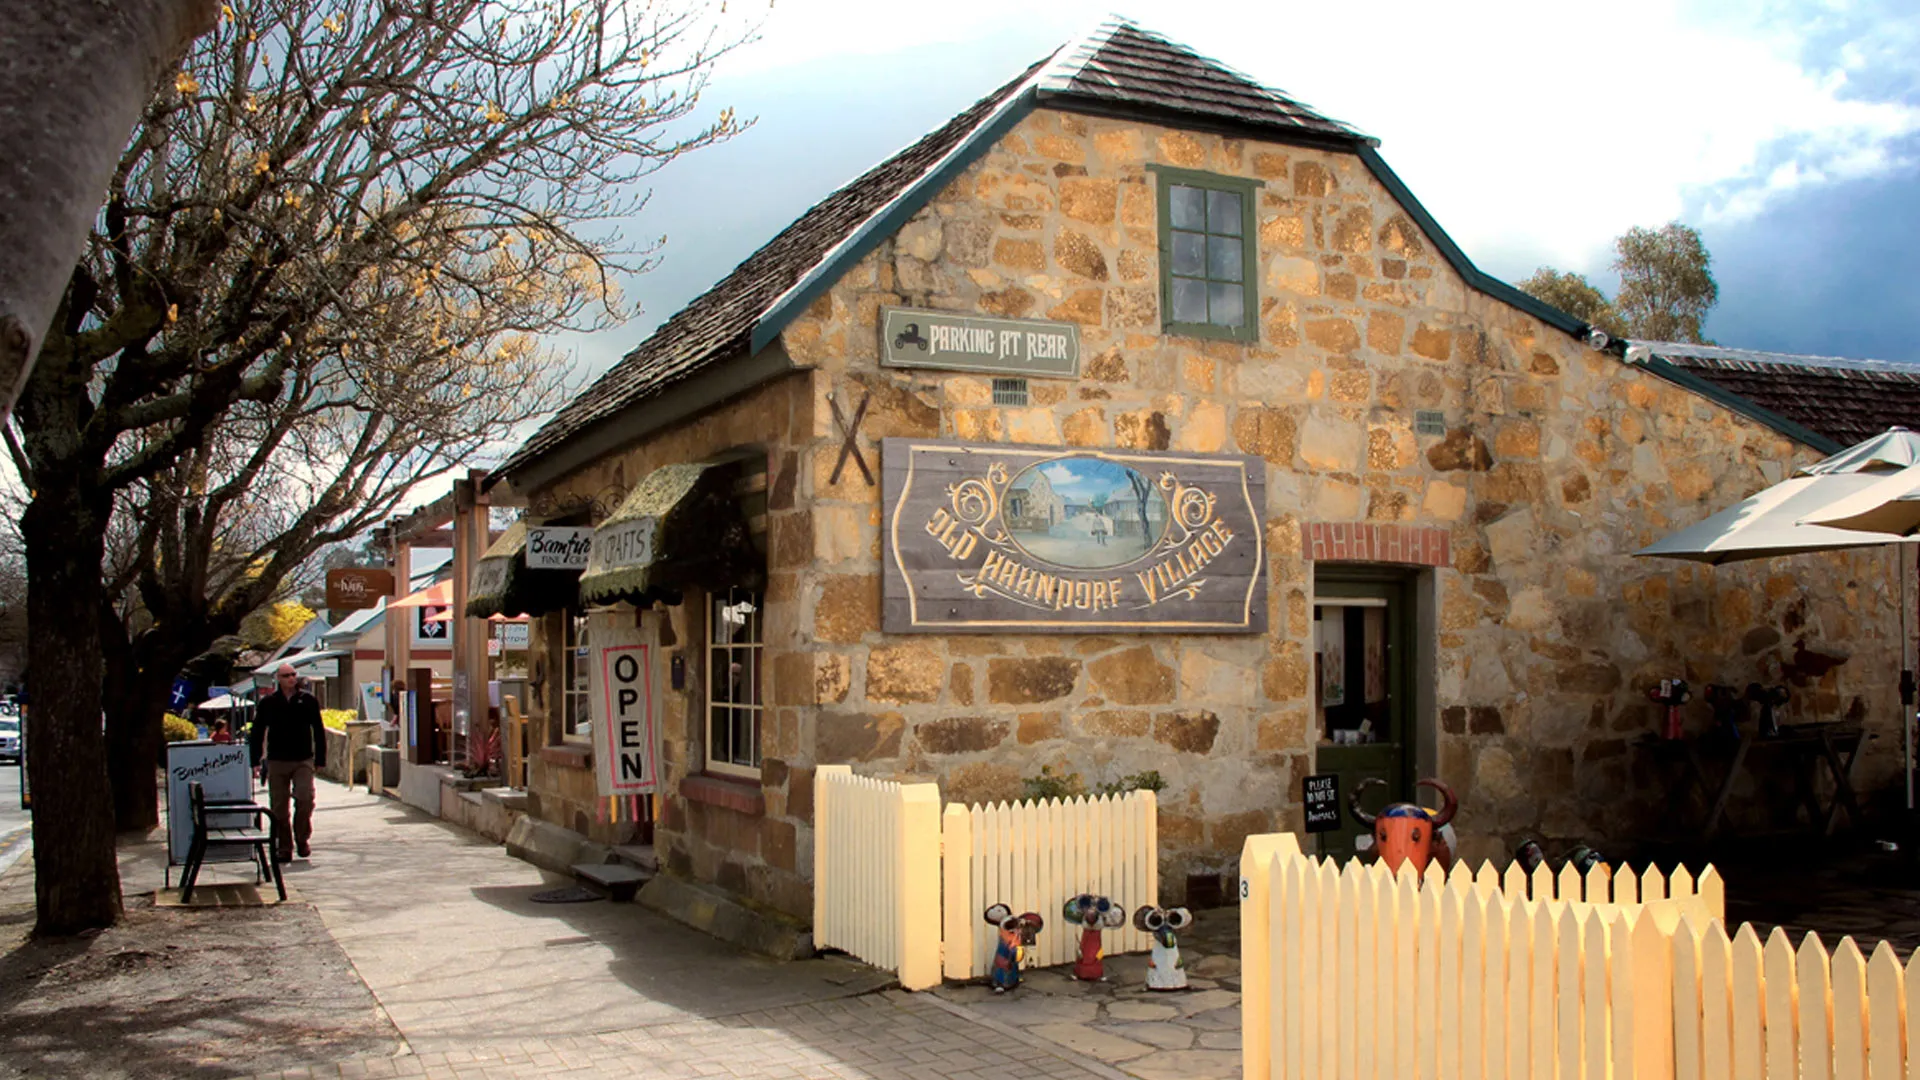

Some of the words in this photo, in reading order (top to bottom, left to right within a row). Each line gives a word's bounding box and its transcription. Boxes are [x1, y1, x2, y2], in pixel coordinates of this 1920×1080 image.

[929, 325, 994, 356] PARKING
[999, 330, 1021, 360] AT
[1026, 332, 1067, 361] REAR
[605, 529, 645, 564] CRAFTS
[925, 507, 978, 561] OLD
[975, 549, 1123, 614] HAHNDORF
[1135, 516, 1235, 605] VILLAGE
[614, 654, 642, 779] OPEN
